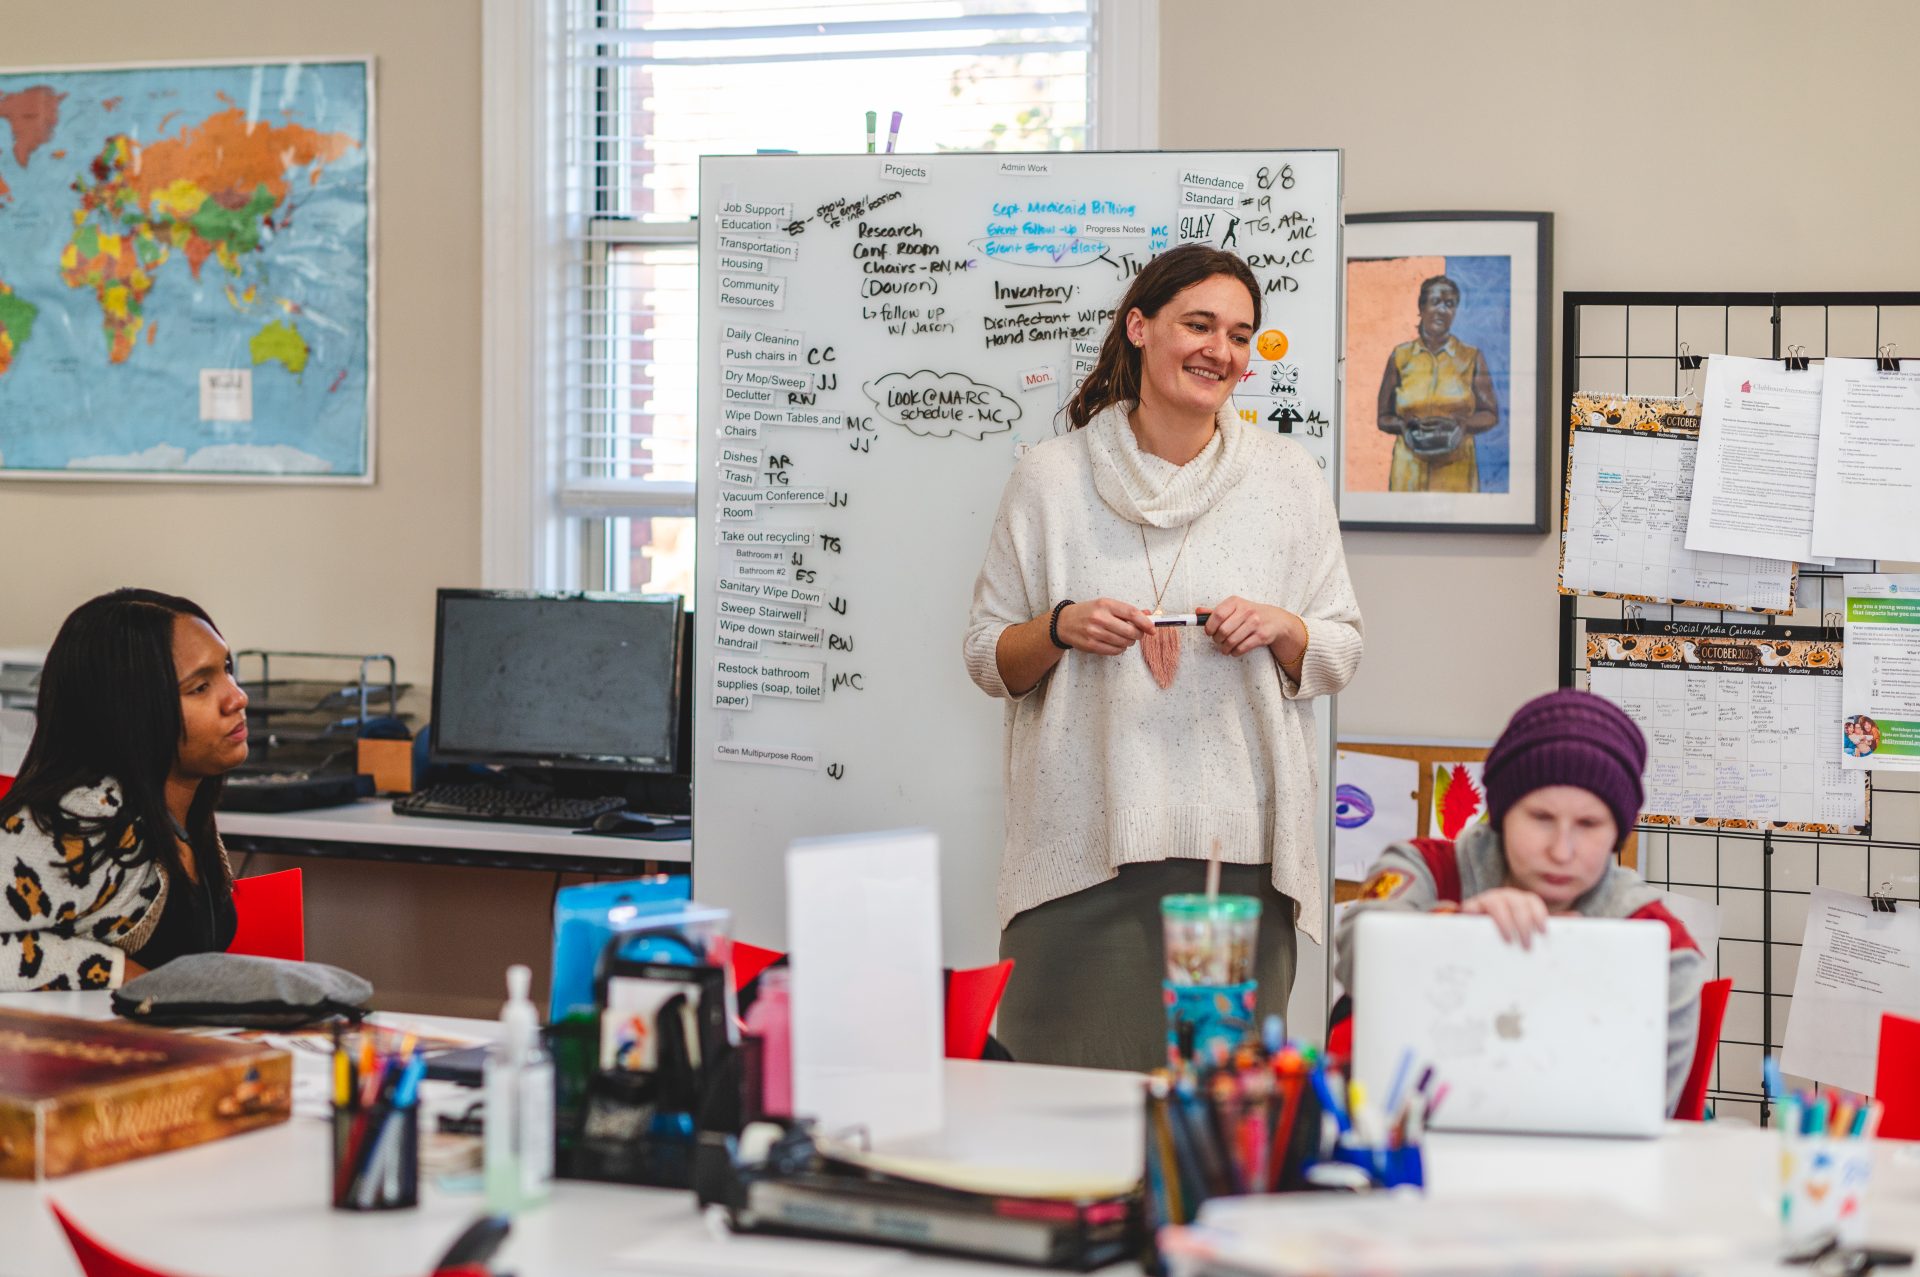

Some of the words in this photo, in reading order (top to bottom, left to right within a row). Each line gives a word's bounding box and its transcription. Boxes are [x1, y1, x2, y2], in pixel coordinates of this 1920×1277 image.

[884, 164, 926, 178] Projects
[1001, 163, 1025, 172] Admin
[1028, 164, 1048, 172] Work
[1184, 172, 1244, 190] Attendance
[1256, 163, 1295, 190] 8/8
[1186, 192, 1234, 206] Standard
[724, 202, 741, 212] Job
[745, 204, 784, 216] Support
[722, 219, 772, 230] Education
[858, 222, 922, 238] Research
[1086, 225, 1120, 234] Progress
[1123, 226, 1146, 234] Notes
[1152, 226, 1168, 236] MC
[1180, 213, 1215, 240] SLAY
[1288, 225, 1317, 242] MC
[720, 237, 791, 255] Transportation
[722, 258, 762, 272] Housing
[864, 261, 916, 274] Chairs
[722, 278, 779, 294] Community
[721, 294, 774, 308] Resources
[880, 302, 919, 321] follow
[984, 312, 1070, 330] Disinfectant
[726, 328, 752, 342] Daily
[888, 321, 906, 336] w/
[912, 322, 954, 334] Jason
[986, 330, 1024, 349] Hand
[726, 349, 752, 360] Push
[755, 350, 784, 361] chairs
[788, 350, 797, 361] in
[808, 346, 836, 365] CC
[1076, 343, 1100, 354] Wee
[725, 370, 743, 382] Dry
[746, 372, 806, 390] Mop/Sweep
[817, 373, 838, 390] JJ
[1026, 373, 1052, 386] Mon.
[726, 389, 772, 401] Declutter
[725, 410, 750, 421] Wipe
[754, 410, 782, 422] Down
[786, 412, 818, 424] Tables
[822, 414, 840, 425] and
[901, 406, 964, 421] schedule
[978, 409, 1004, 424] MC
[724, 425, 757, 437] Chairs
[723, 450, 758, 464] Dishes
[725, 470, 752, 484] Trash
[764, 471, 789, 486] TG
[723, 492, 762, 502] Vacuum
[766, 490, 824, 502] Conference
[829, 492, 848, 508] JJ
[723, 507, 752, 518] Room
[722, 531, 744, 542] Take
[747, 532, 763, 542] out
[766, 531, 810, 544] recycling
[820, 534, 842, 554] TG
[736, 550, 772, 560] Bathroom
[774, 552, 783, 560] #1
[739, 566, 774, 576] Bathroom
[776, 568, 786, 576] #2
[796, 569, 816, 584] ES
[720, 580, 760, 596] Sanitary
[763, 586, 788, 598] Wipe
[792, 590, 820, 602] Down
[721, 602, 756, 616] Sweep
[759, 606, 802, 620] Stairwell
[720, 620, 746, 632] Wipe
[748, 624, 774, 636] down
[778, 629, 819, 643] stairwell
[1671, 622, 1700, 634] Social
[1701, 624, 1726, 636] Media
[1729, 626, 1766, 636] Calendar
[718, 636, 758, 650] handrail
[1702, 647, 1738, 659] OCTOBER
[718, 662, 758, 676] Restock
[762, 668, 810, 679] bathroom
[717, 679, 758, 691] supplies
[762, 682, 792, 695] (soap,
[796, 686, 820, 696] toilet
[716, 695, 749, 707] paper)
[718, 746, 739, 756] Clean
[742, 748, 788, 761] Multipurpose
[791, 753, 814, 762] Room
